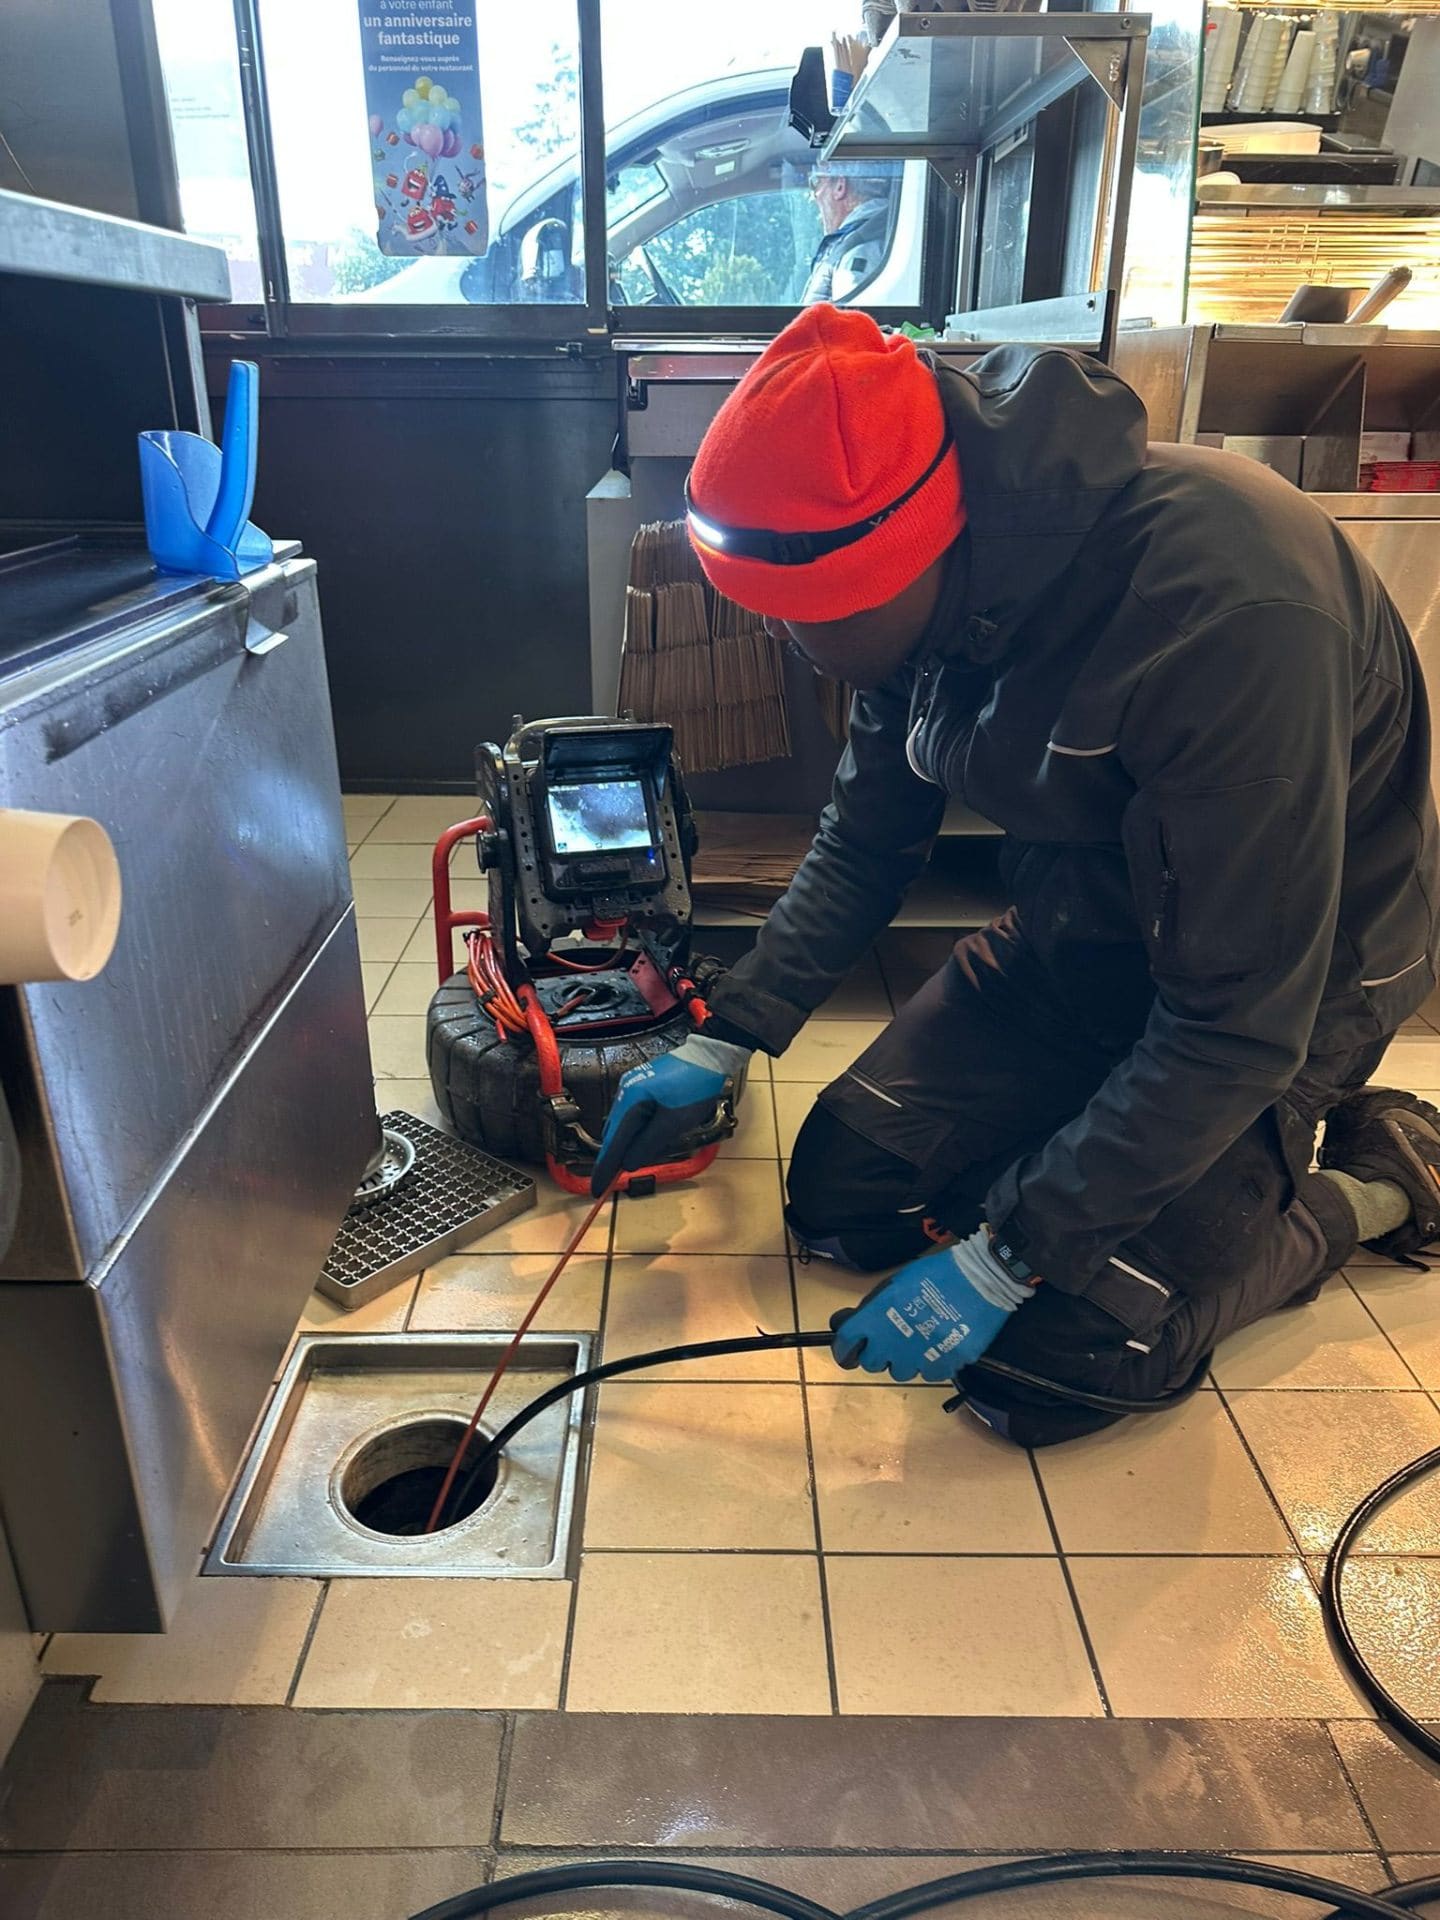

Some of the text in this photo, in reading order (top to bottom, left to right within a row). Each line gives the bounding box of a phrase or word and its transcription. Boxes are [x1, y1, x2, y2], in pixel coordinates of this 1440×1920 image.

[388, 0, 417, 9] votre
[418, 0, 454, 10] enfant
[363, 13, 472, 27] un anniversaire
[378, 31, 460, 48] fantastique
[380, 55, 436, 64] Renseignez-vous
[378, 64, 411, 73] personnel
[420, 64, 438, 72] votre
